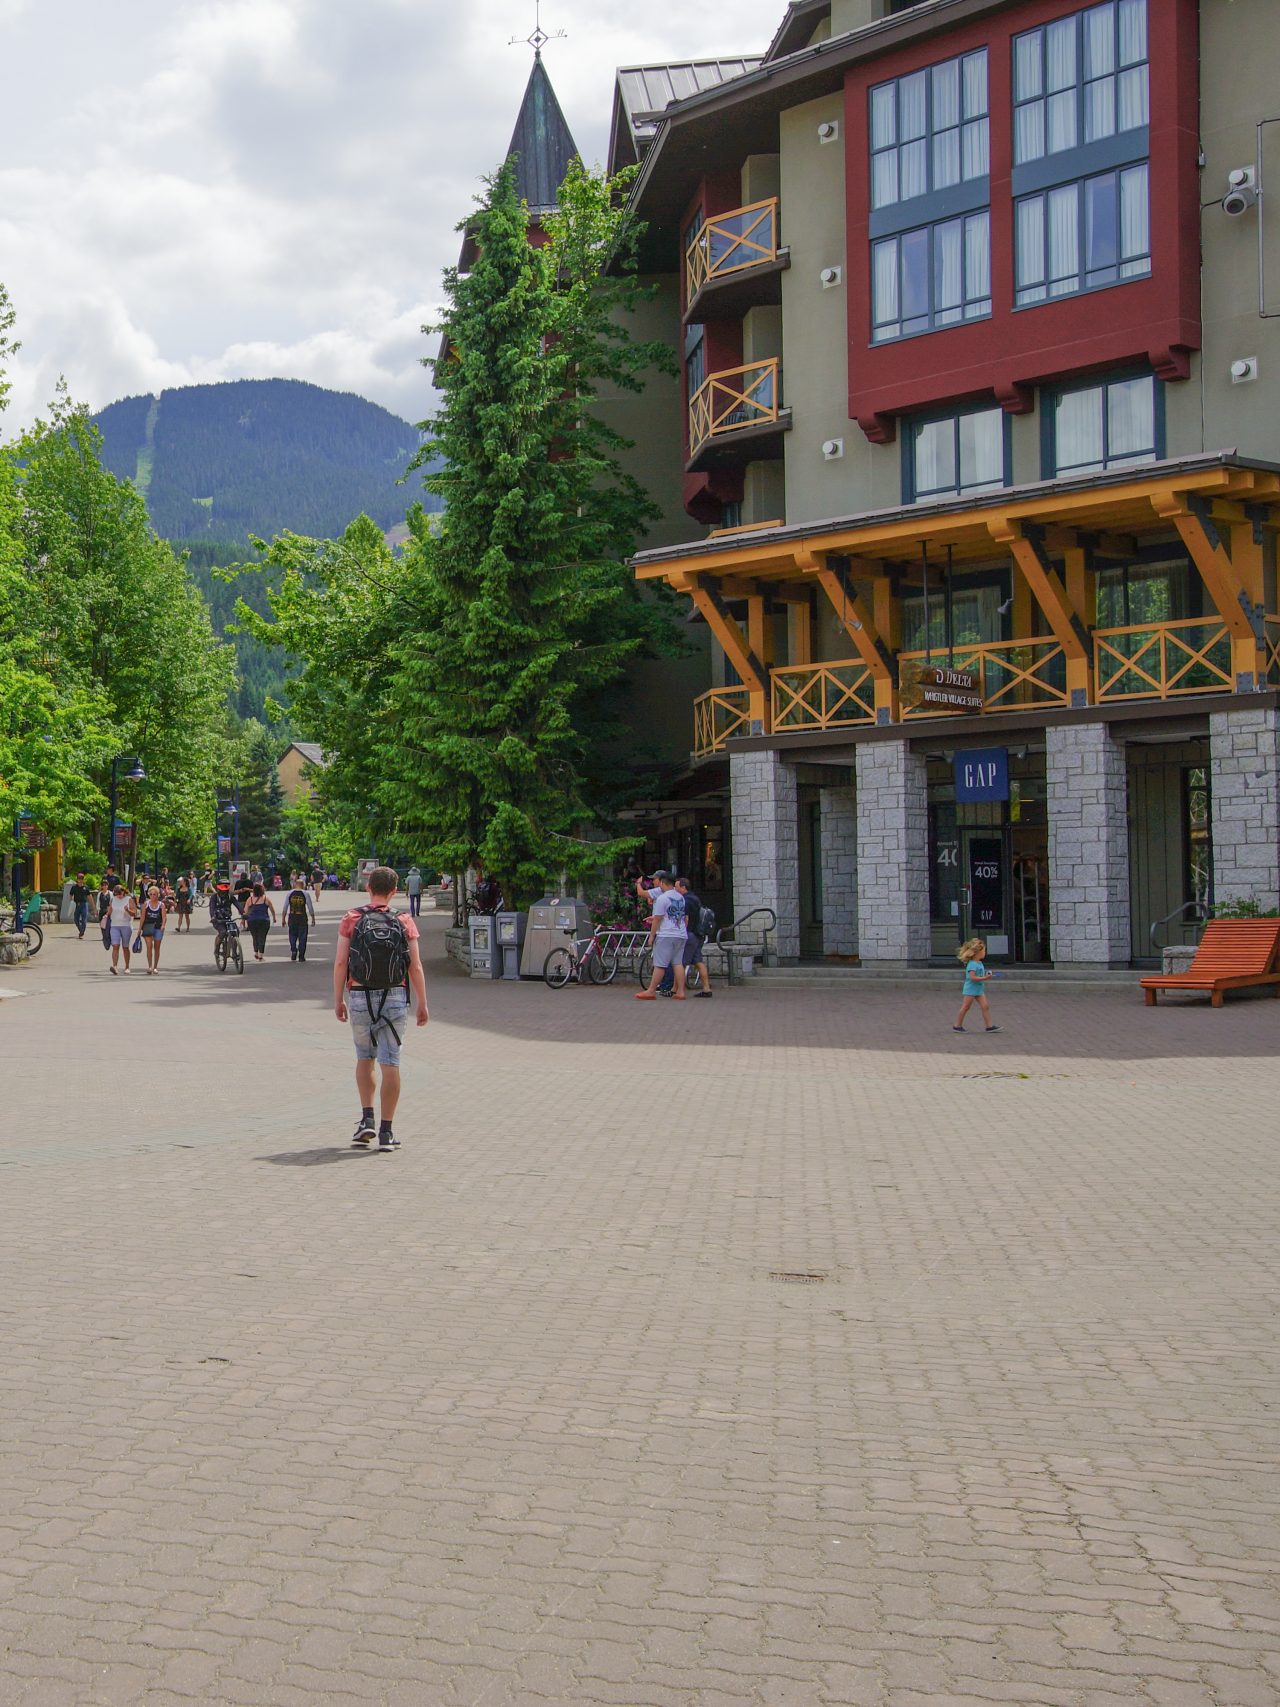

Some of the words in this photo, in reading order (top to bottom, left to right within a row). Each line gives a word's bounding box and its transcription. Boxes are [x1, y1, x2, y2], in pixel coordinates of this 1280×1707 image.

[946, 671, 972, 688] DELTA
[924, 690, 948, 703] WHISTLER
[948, 694, 967, 705] VILLAGE
[967, 697, 983, 708] SUITES
[964, 762, 997, 788] GAP
[975, 866, 998, 878] 40%
